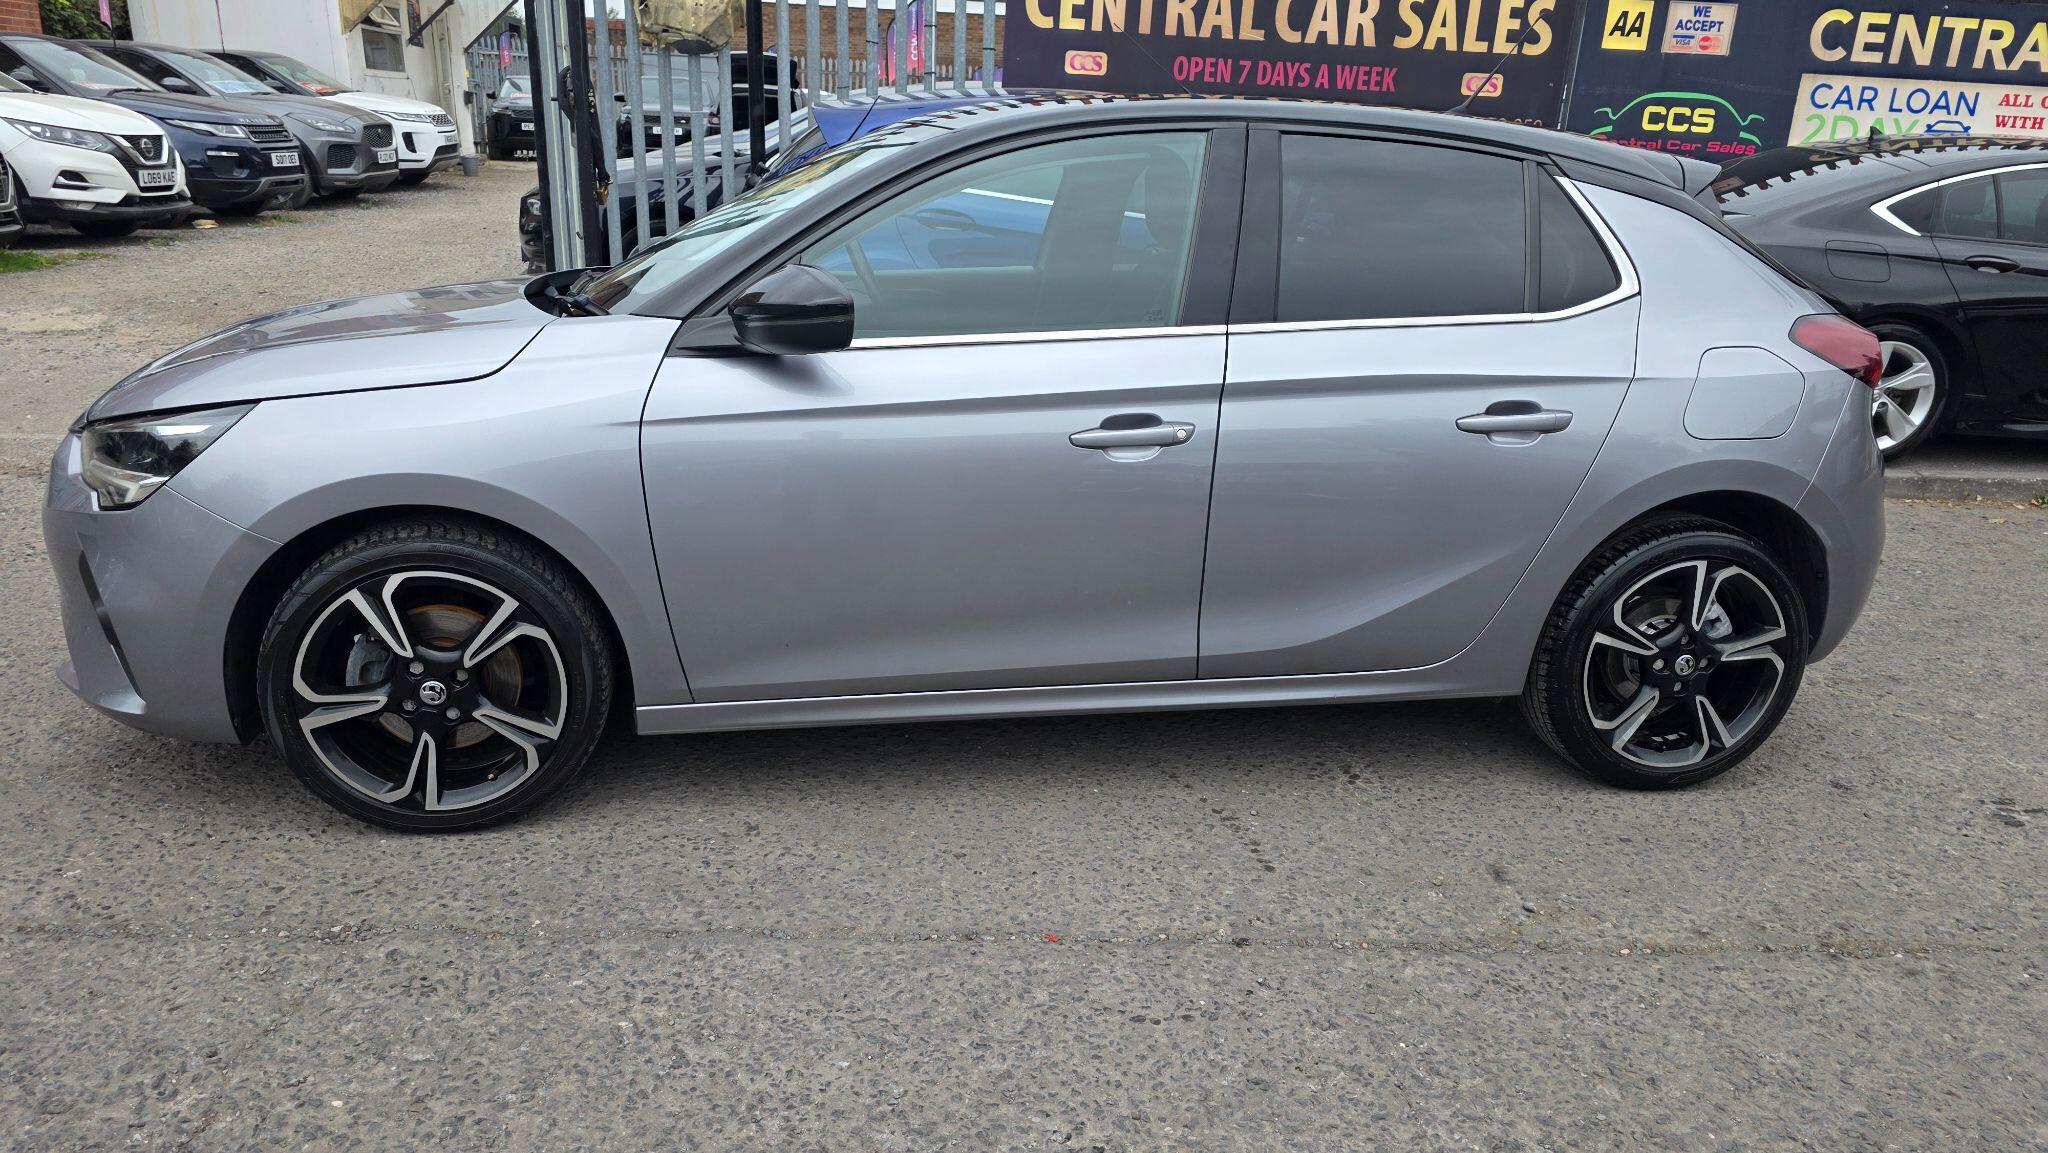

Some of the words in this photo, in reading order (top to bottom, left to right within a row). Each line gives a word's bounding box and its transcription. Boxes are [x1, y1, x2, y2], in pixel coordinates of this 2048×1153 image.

[1693, 5, 1712, 18] WE
[1275, 0, 1377, 47] CAR
[1393, 0, 1555, 56] SALES
[1608, 10, 1646, 38] AA
[1675, 19, 1724, 32] ACCEPT
[1675, 38, 1691, 46] VISA
[1809, 8, 2048, 73] CENTRA
[1173, 56, 1232, 83] OPEN
[1238, 60, 1252, 84] 7
[1256, 61, 1311, 88] DAYS
[1315, 63, 1329, 89] A
[1336, 65, 1398, 93] WEEK
[1810, 83, 1879, 111] CAR
[1888, 88, 1980, 117] LOAN
[1998, 93, 2034, 107] ALL
[1641, 105, 1715, 134] CCS
[1995, 115, 2046, 130] WITH
[1666, 139, 1702, 151] Car
[1706, 141, 1756, 155] Sales
[142, 172, 162, 184] LO69
[163, 171, 176, 183] KAE
